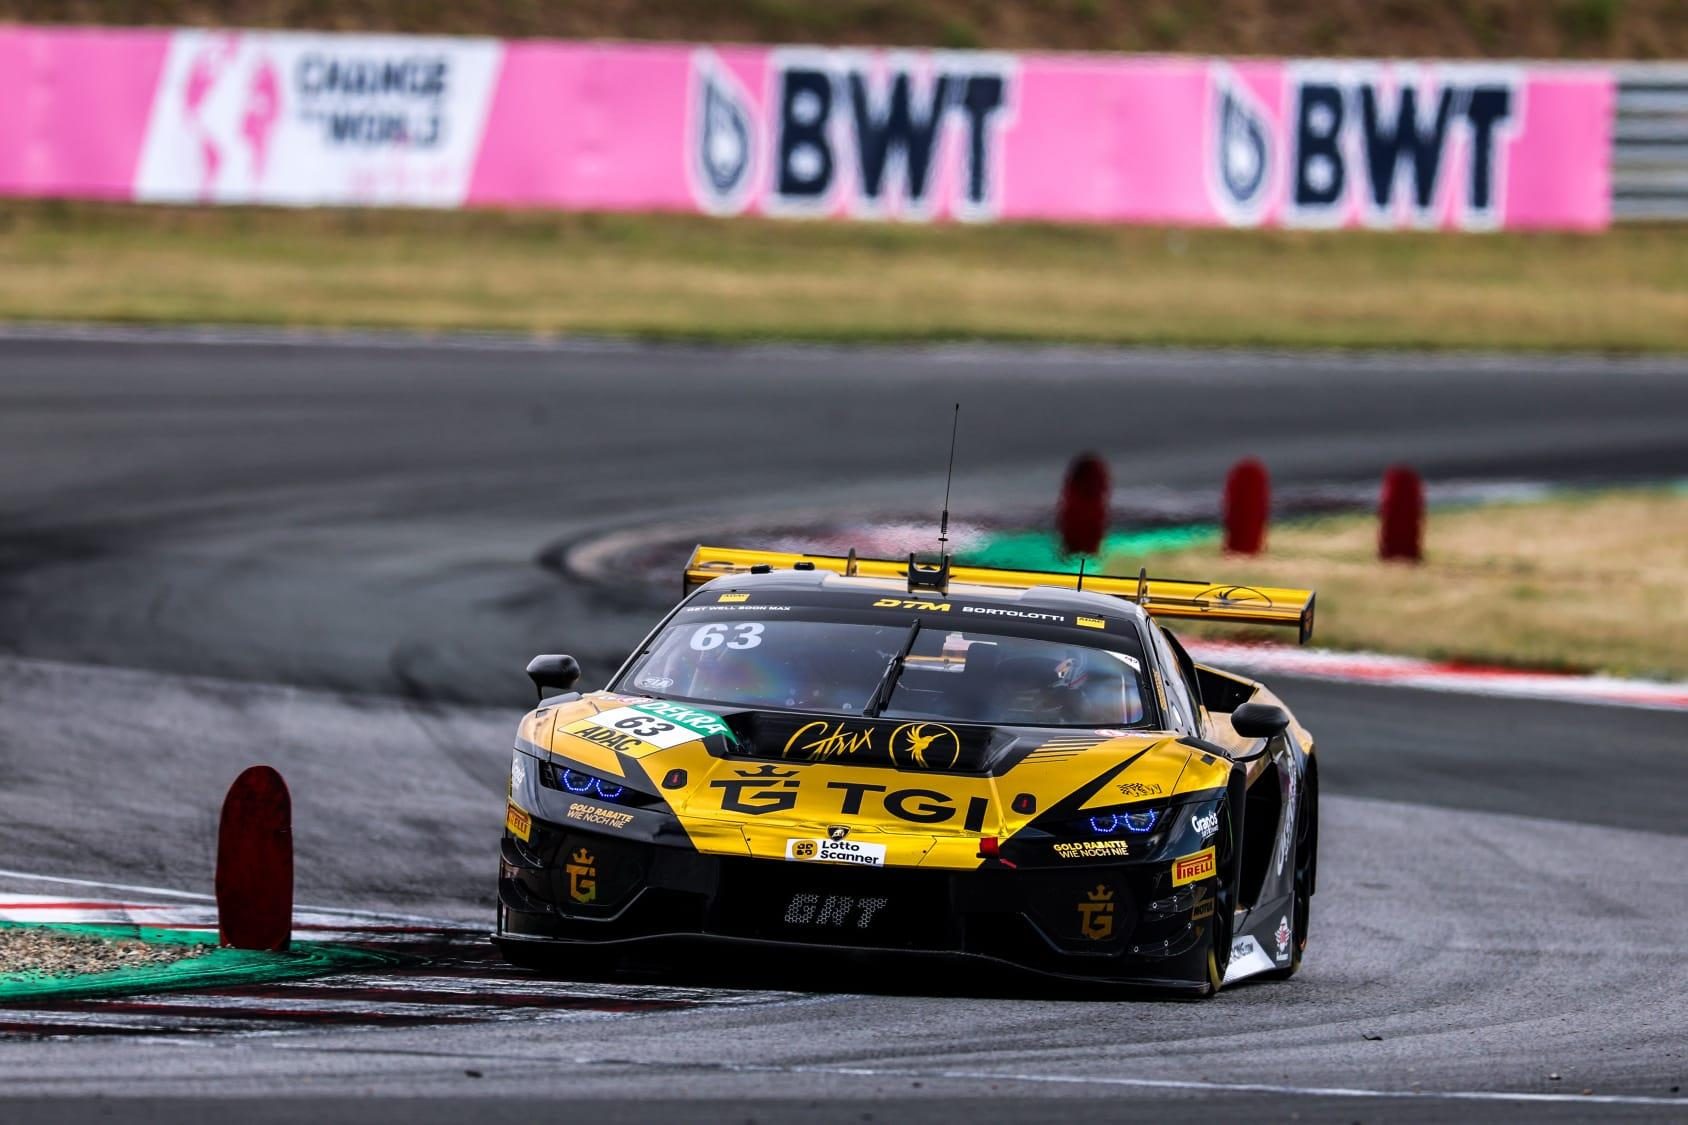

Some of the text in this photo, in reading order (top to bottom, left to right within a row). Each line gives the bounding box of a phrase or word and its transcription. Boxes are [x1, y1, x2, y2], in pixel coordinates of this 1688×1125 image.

[776, 68, 1009, 199] BWT
[1292, 83, 1514, 210] BWT
[872, 598, 1064, 622] DTM BORTOLOTTI
[690, 622, 765, 650] 63
[614, 716, 675, 737] 63
[639, 701, 728, 734] DEKRA
[574, 726, 642, 751] ADAC
[567, 809, 627, 829] WIE NOCH NIE
[569, 803, 635, 823] GOLD RABATTE
[827, 782, 989, 833] TGI
[820, 849, 880, 865] Scanner
[822, 840, 860, 852] Lotto
[1053, 840, 1129, 852] GOLD RABATTE
[1059, 847, 1130, 859] WIE NOCH NIE
[1176, 853, 1213, 881] PIRELLI
